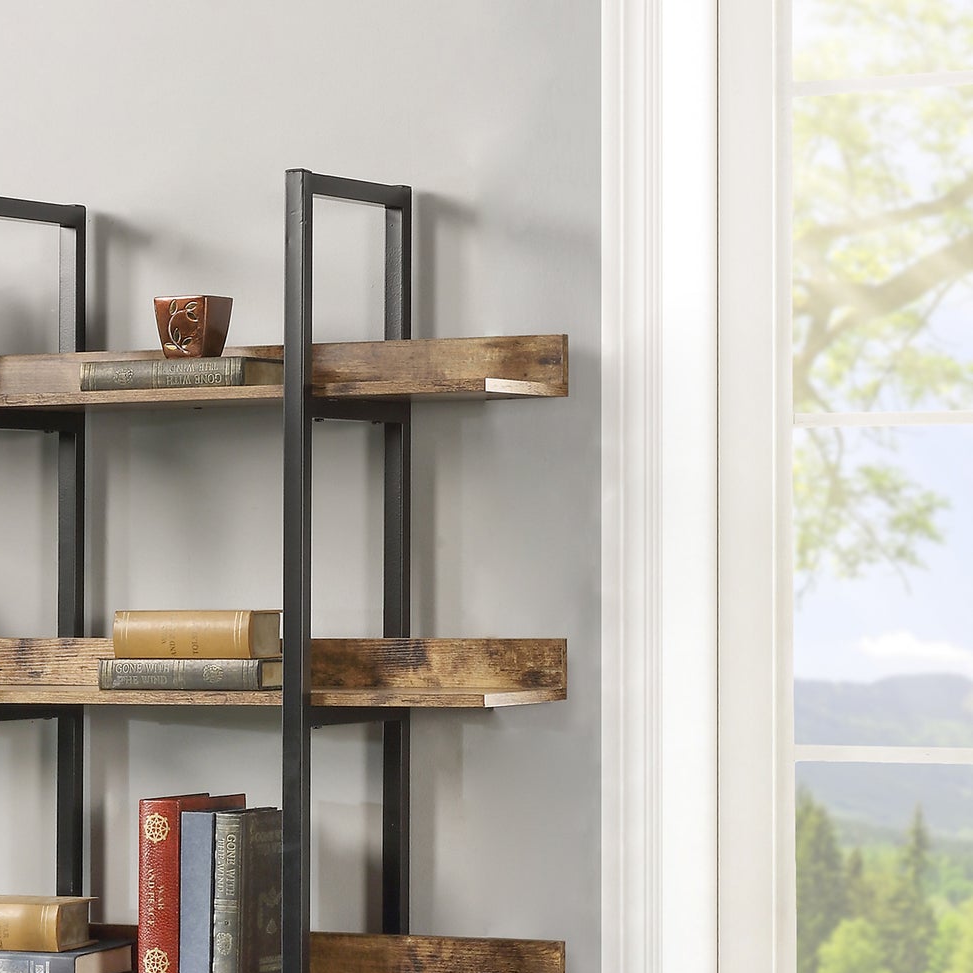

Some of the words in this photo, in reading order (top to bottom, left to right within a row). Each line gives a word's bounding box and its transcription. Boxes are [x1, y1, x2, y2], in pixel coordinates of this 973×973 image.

[166, 374, 192, 385] WITH
[195, 373, 223, 385] GONE
[115, 663, 143, 674] GONE
[145, 662, 170, 674] WITH
[141, 674, 168, 685] WIND
[217, 838, 225, 860] THE
[226, 834, 237, 865] GONE
[217, 864, 225, 893] WIND
[225, 868, 236, 896] WITH
